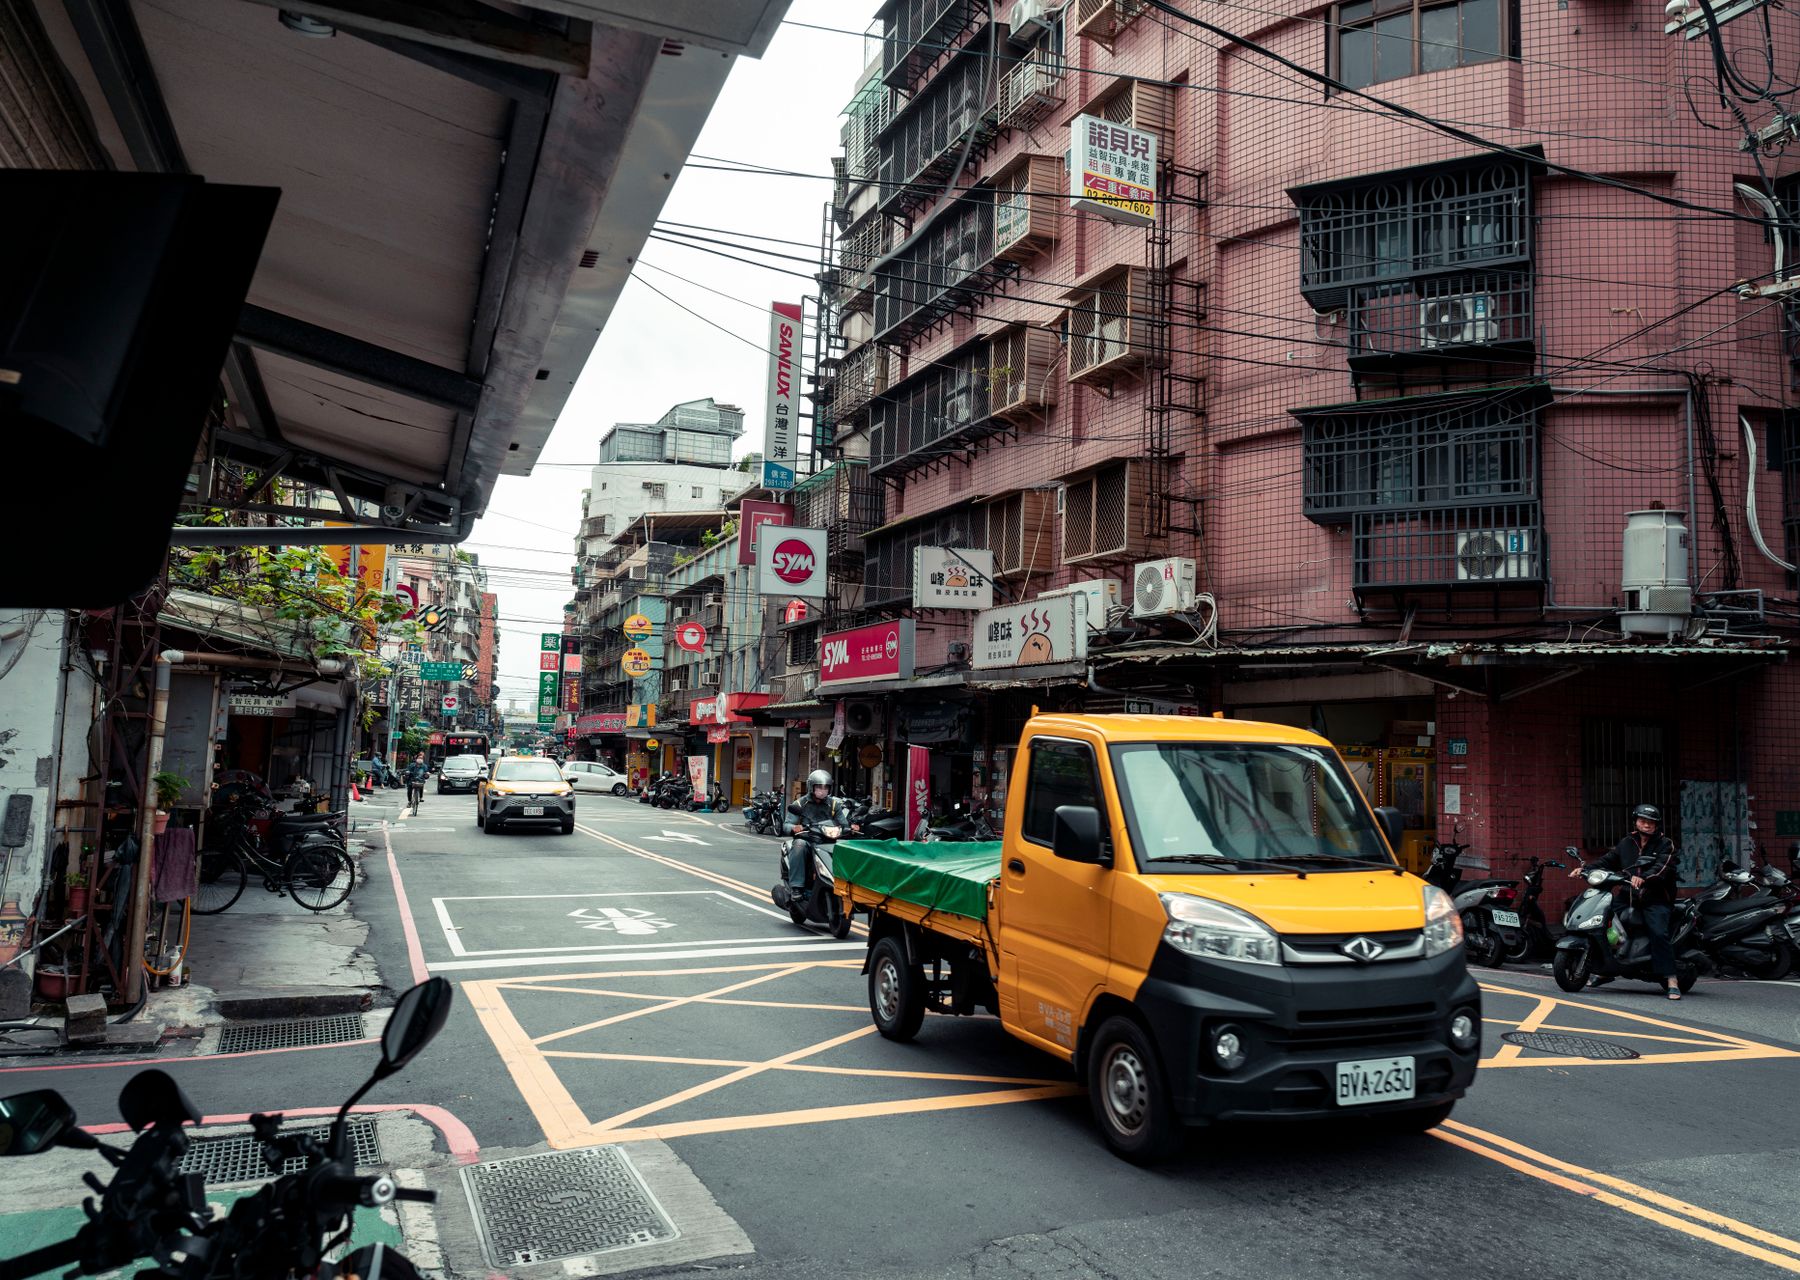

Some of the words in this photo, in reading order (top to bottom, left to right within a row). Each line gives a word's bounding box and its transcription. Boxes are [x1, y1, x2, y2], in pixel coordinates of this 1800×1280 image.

[1089, 121, 1150, 161] 諾貝兒
[776, 322, 793, 400] SANLUX
[773, 402, 790, 459] 台灣三洋
[771, 552, 815, 575] SYM
[988, 618, 1012, 642] 峰味
[823, 640, 850, 673] SYM
[1340, 1067, 1412, 1098] BVA-2630
